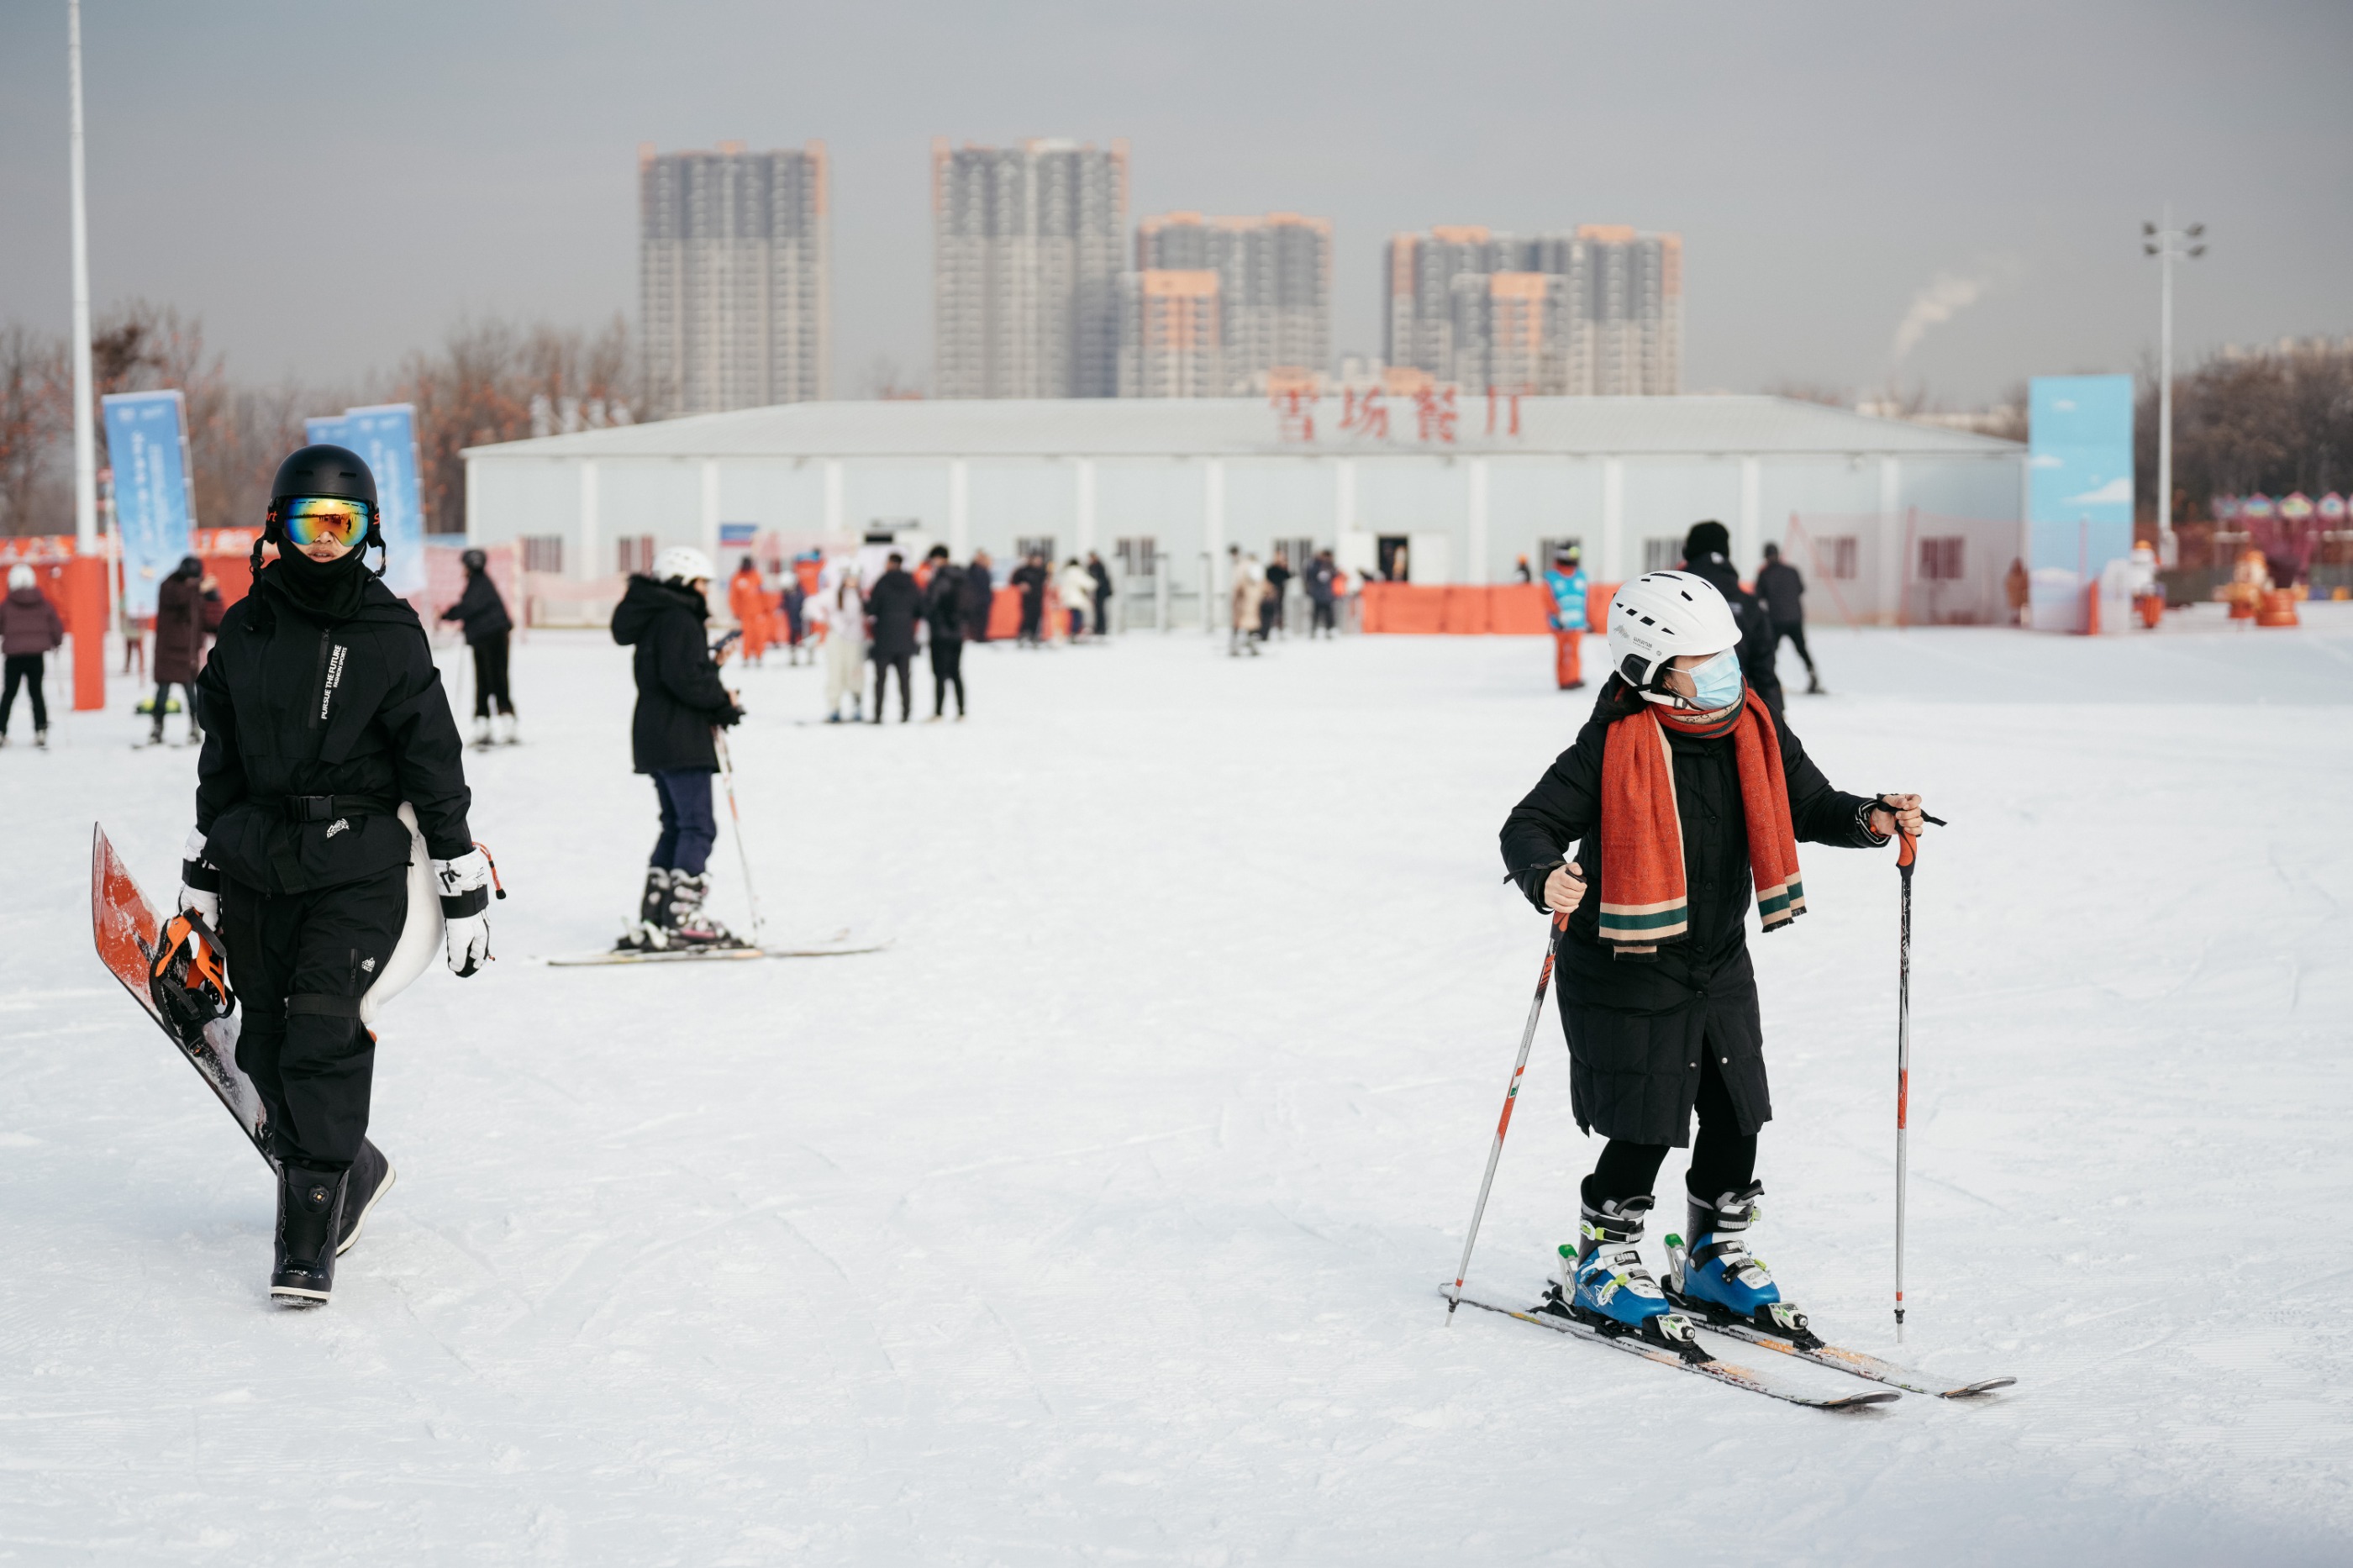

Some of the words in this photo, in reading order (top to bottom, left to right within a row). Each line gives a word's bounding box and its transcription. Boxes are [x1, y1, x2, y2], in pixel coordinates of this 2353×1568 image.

[1270, 383, 1535, 444] 雪场餐厅
[329, 645, 341, 673] FUTURE
[333, 666, 342, 687] FASHION
[339, 647, 347, 666] SPORTS
[325, 673, 334, 688] THE
[321, 689, 331, 719] PURSUE
